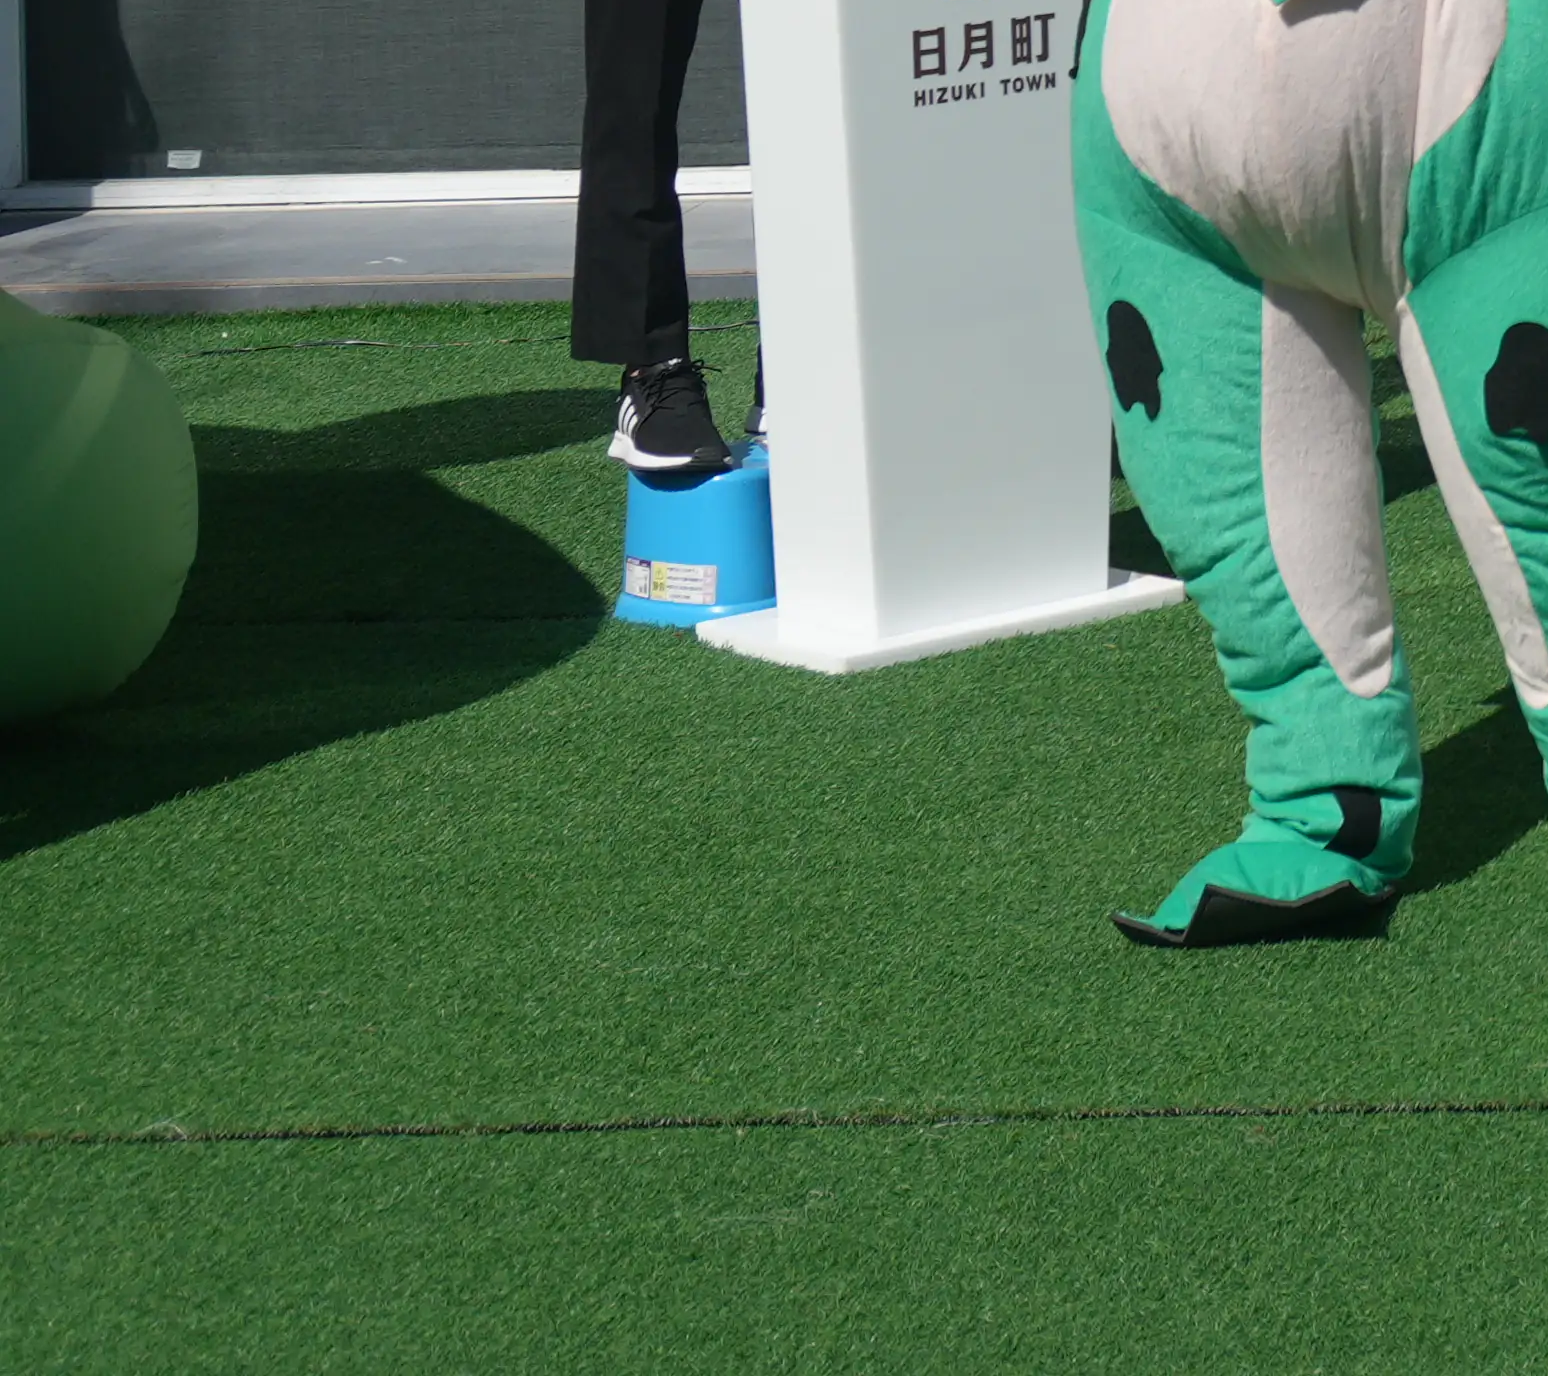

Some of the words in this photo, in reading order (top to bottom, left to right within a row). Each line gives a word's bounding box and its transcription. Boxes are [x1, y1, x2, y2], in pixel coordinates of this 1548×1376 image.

[911, 12, 1056, 79] 日月町
[914, 82, 986, 108] HIZUKI
[1000, 72, 1057, 96] TOWN
